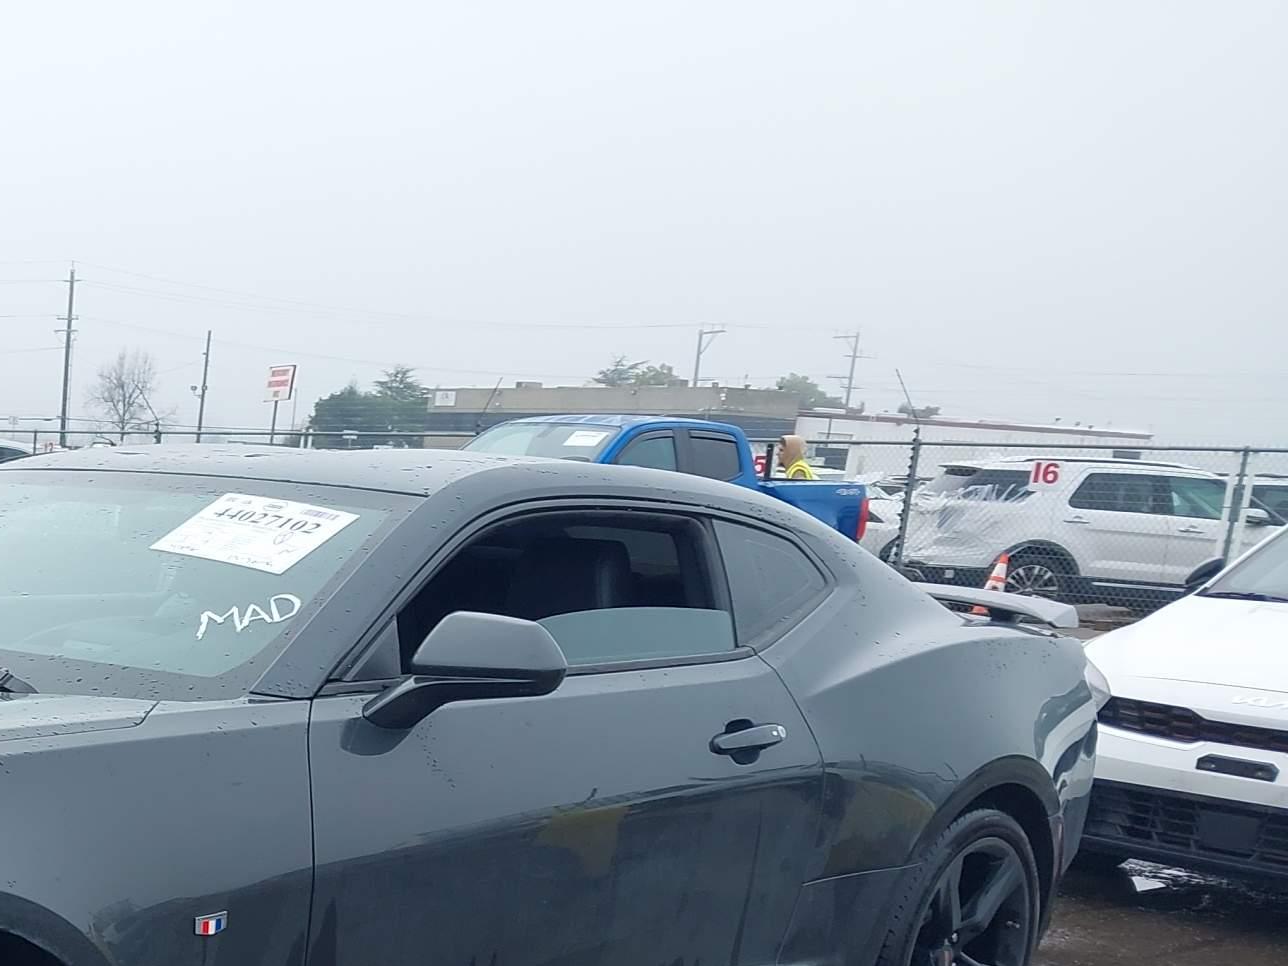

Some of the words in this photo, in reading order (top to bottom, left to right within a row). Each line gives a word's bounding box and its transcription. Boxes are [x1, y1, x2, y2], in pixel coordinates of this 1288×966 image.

[1032, 461, 1061, 485] 16
[213, 506, 323, 535] 44027102
[195, 593, 302, 641] MAD
